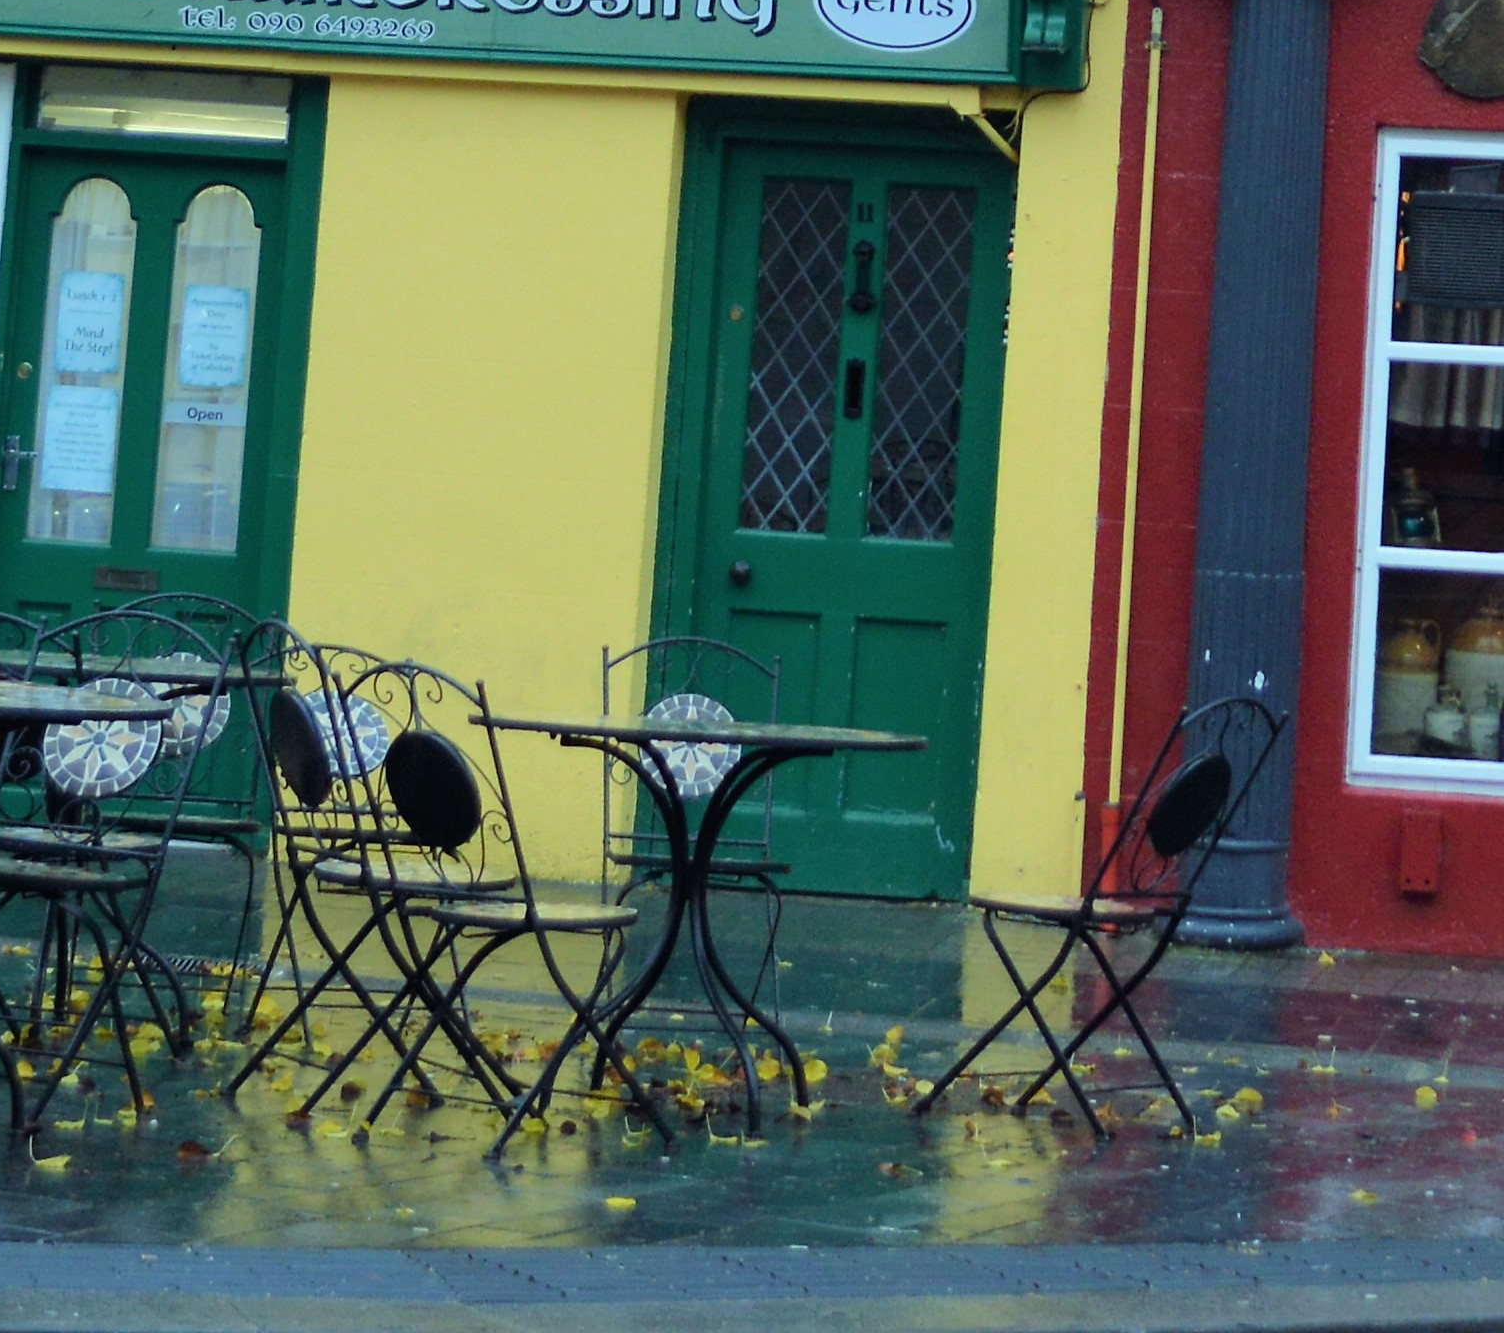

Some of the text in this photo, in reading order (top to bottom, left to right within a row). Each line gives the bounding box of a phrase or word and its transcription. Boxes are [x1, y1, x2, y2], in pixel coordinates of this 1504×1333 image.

[247, 10, 305, 35] 090
[313, 17, 436, 42] 6493269
[75, 326, 105, 339] Mind
[65, 338, 85, 353] The
[186, 406, 224, 422] Open
